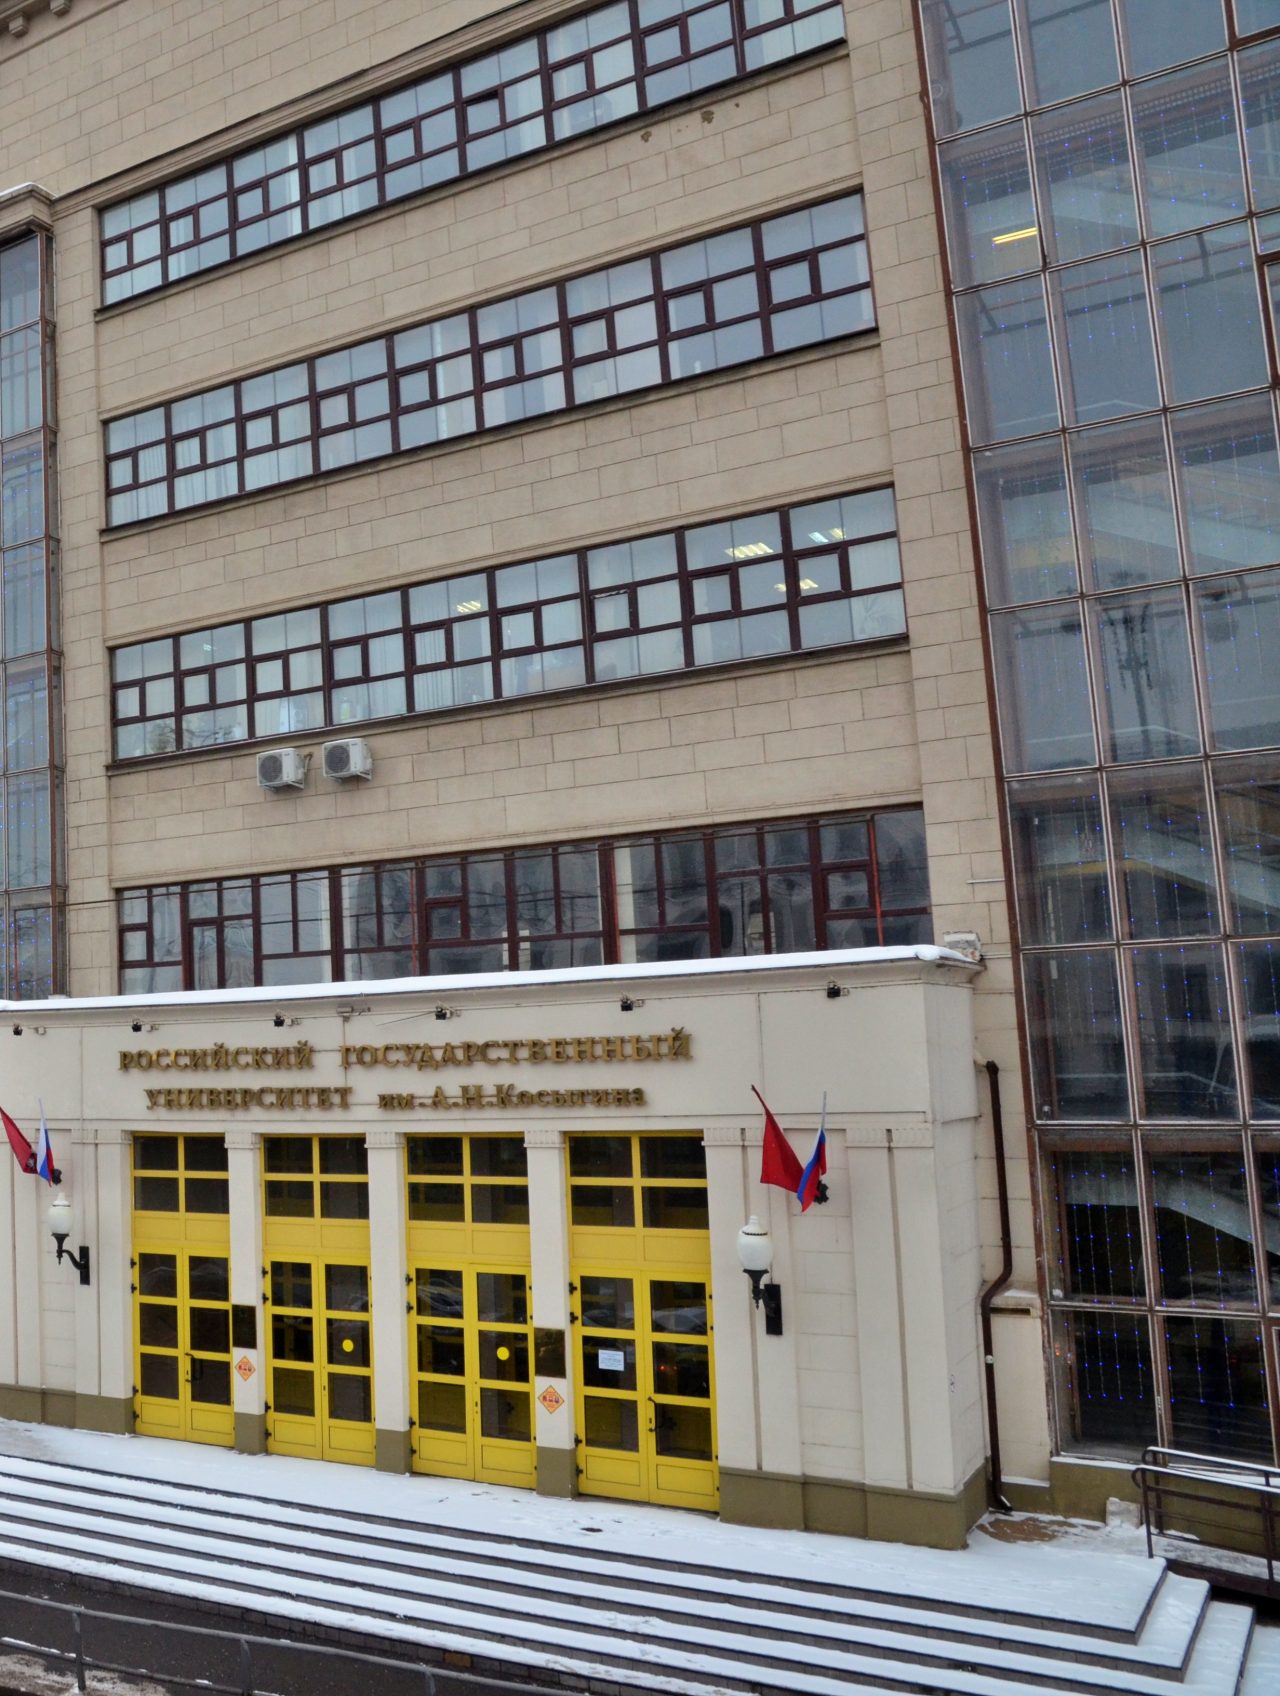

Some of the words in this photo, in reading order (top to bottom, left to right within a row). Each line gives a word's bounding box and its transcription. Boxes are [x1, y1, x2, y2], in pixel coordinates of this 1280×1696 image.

[118, 1040, 315, 1072] РОССИЙСКИЙ
[339, 1027, 694, 1071] ГОСУДАРСТВЕННЫЙ
[144, 1086, 353, 1111] УНИВЕРСИТЕТ
